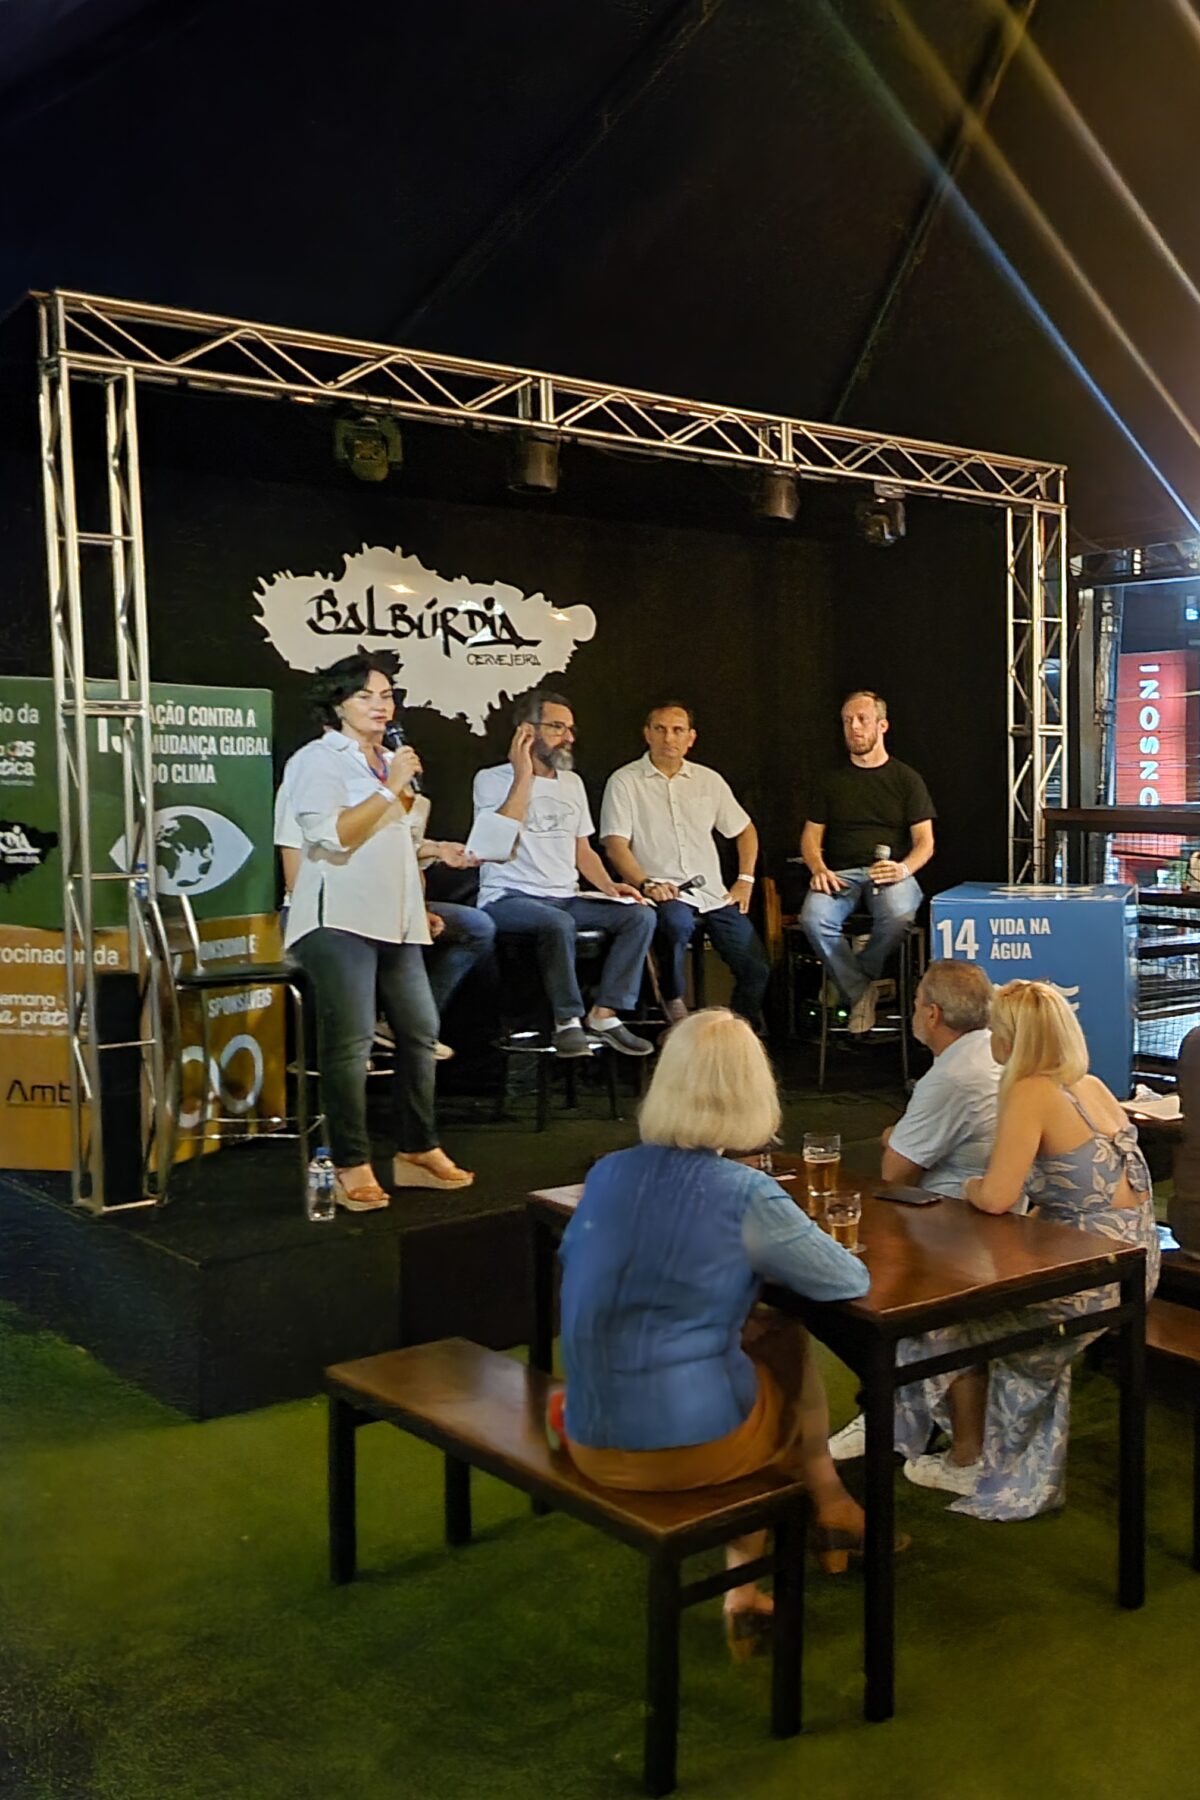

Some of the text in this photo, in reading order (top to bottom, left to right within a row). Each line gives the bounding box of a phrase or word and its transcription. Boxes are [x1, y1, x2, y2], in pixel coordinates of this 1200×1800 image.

[17, 702, 40, 724] da
[188, 704, 244, 727] CONTRA
[246, 709, 256, 727] A
[219, 736, 271, 755] GLOBAL
[171, 764, 216, 783] CLIMA
[990, 918, 1051, 935] VIDA NA
[937, 919, 979, 960] 14
[990, 938, 1032, 960] ÁGUA
[94, 945, 119, 965] da
